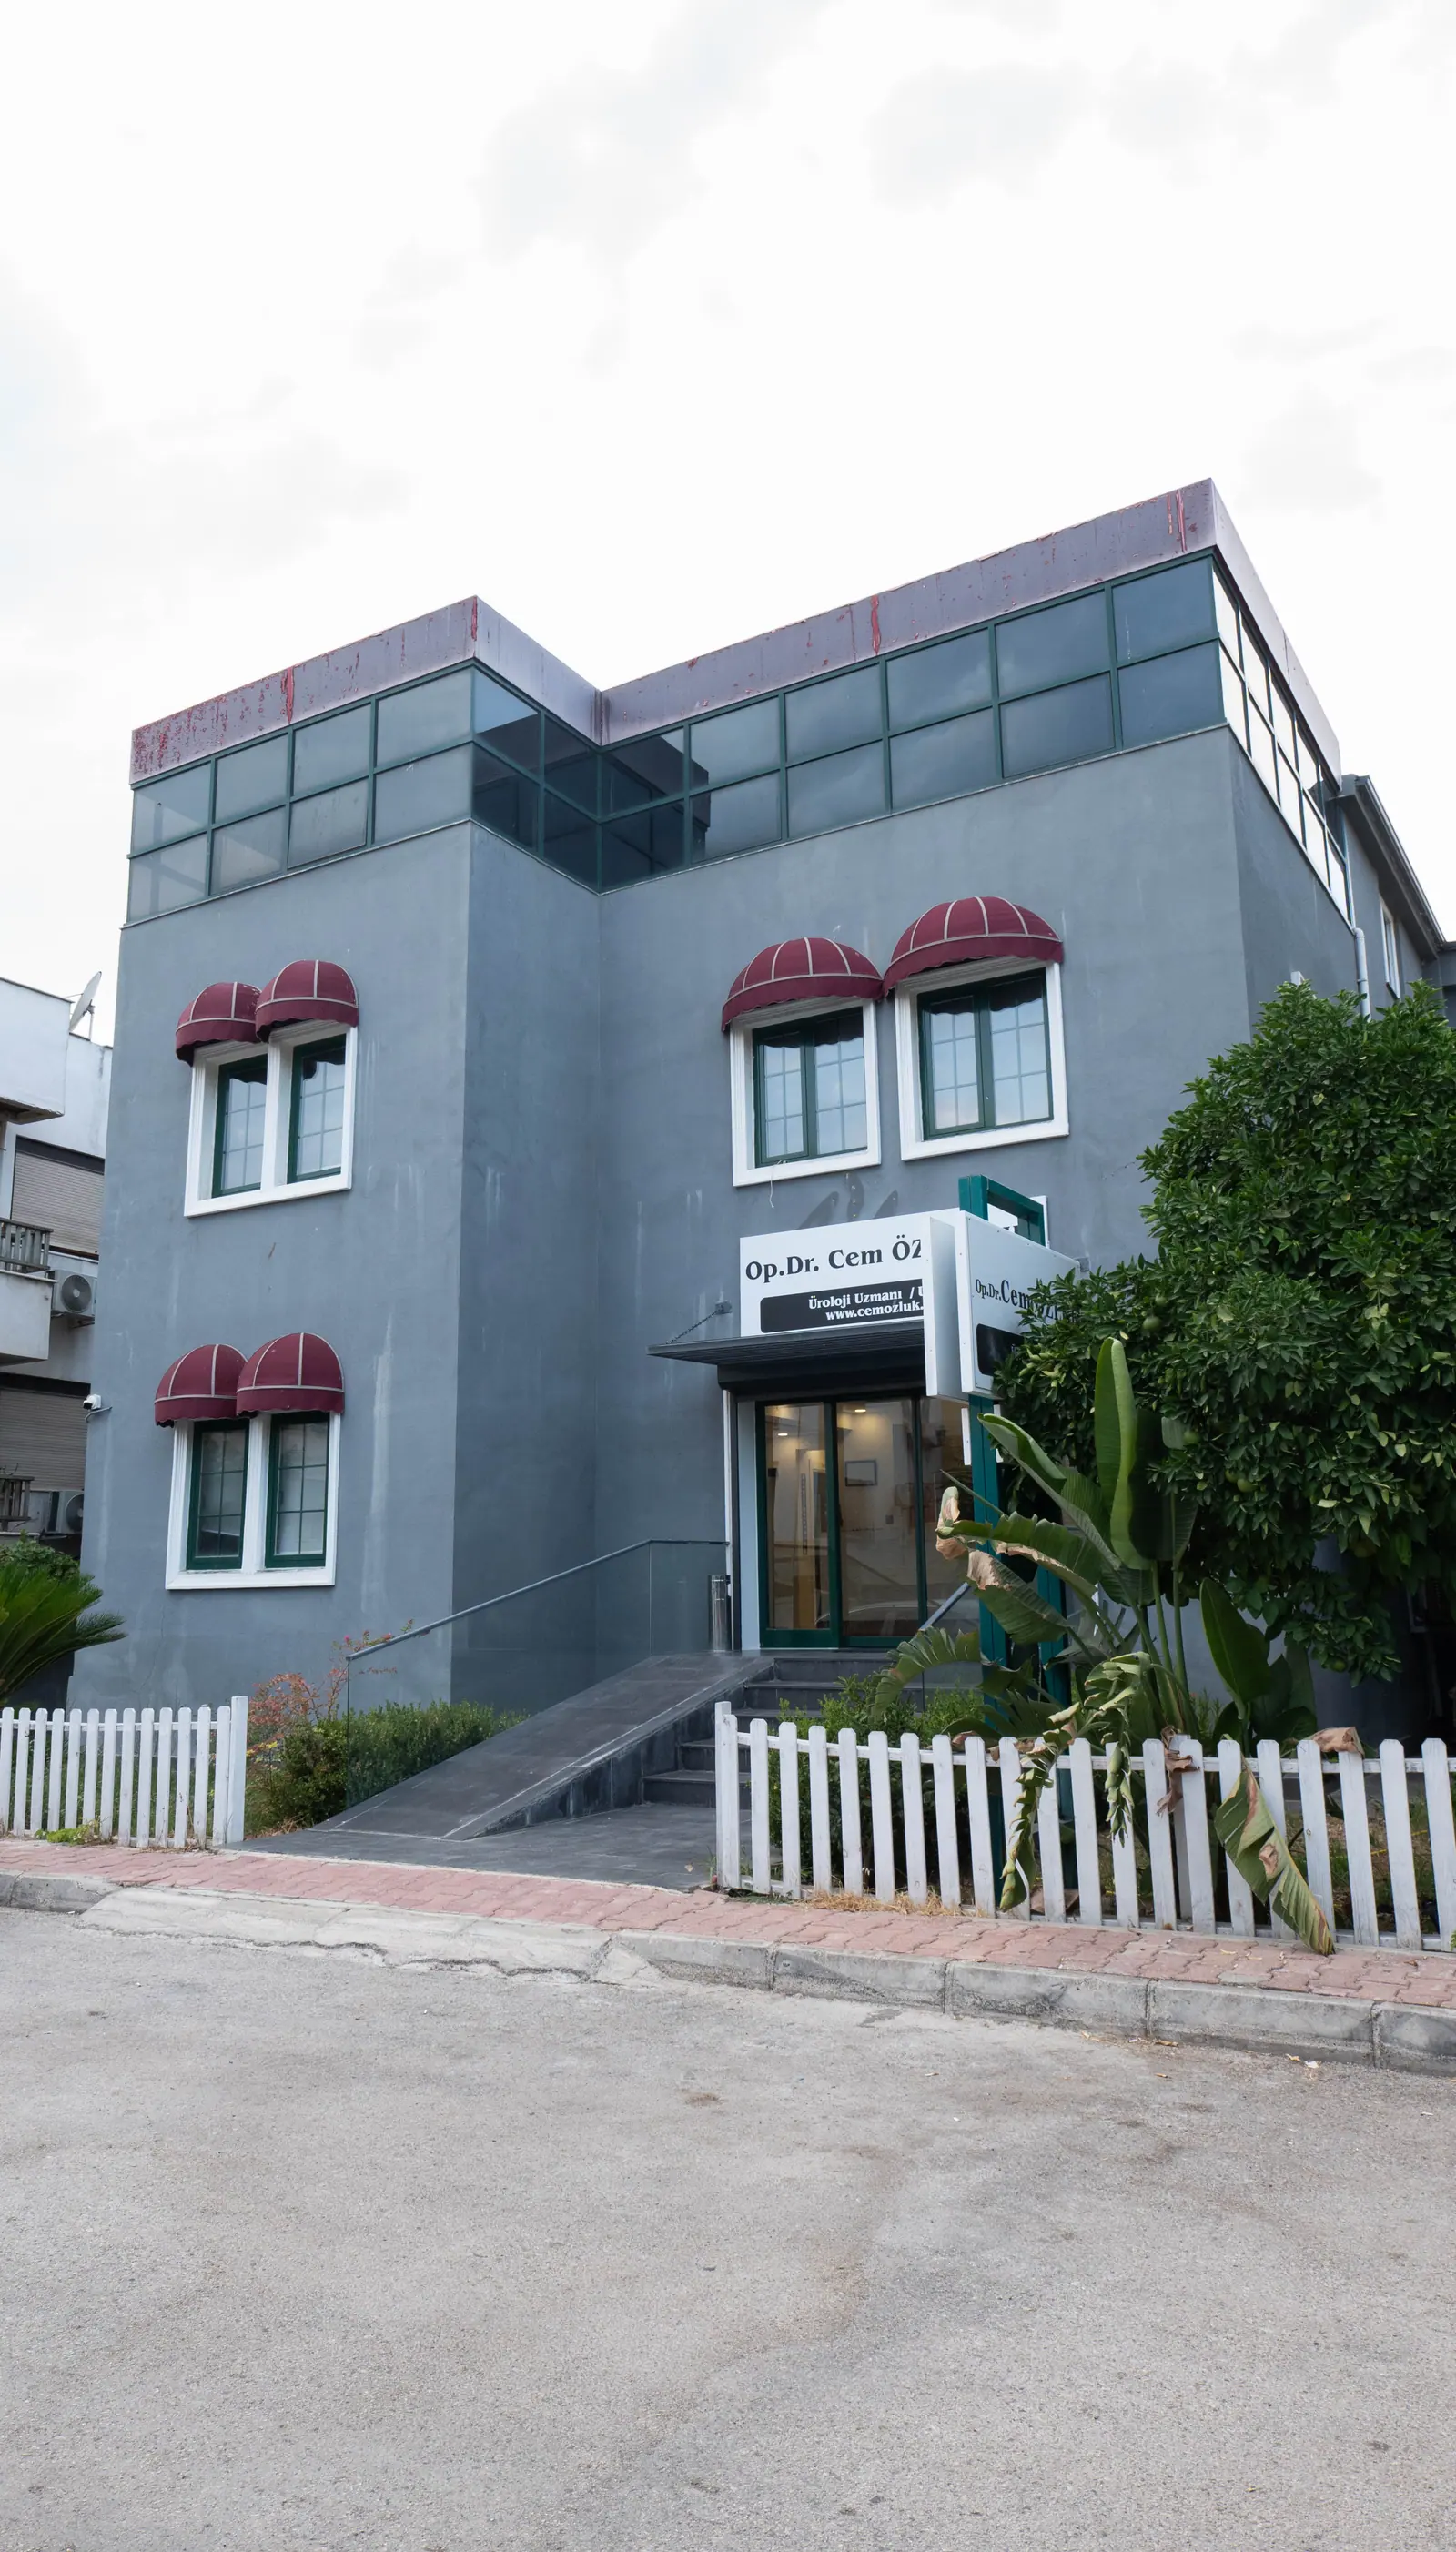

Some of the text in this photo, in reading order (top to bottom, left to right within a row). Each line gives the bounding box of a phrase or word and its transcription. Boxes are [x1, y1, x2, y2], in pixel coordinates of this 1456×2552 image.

[745, 1255, 819, 1283] Op.Dr.
[828, 1249, 883, 1269] Cem
[808, 1294, 851, 1310] Üroloji
[854, 1290, 903, 1304] Uzmanı
